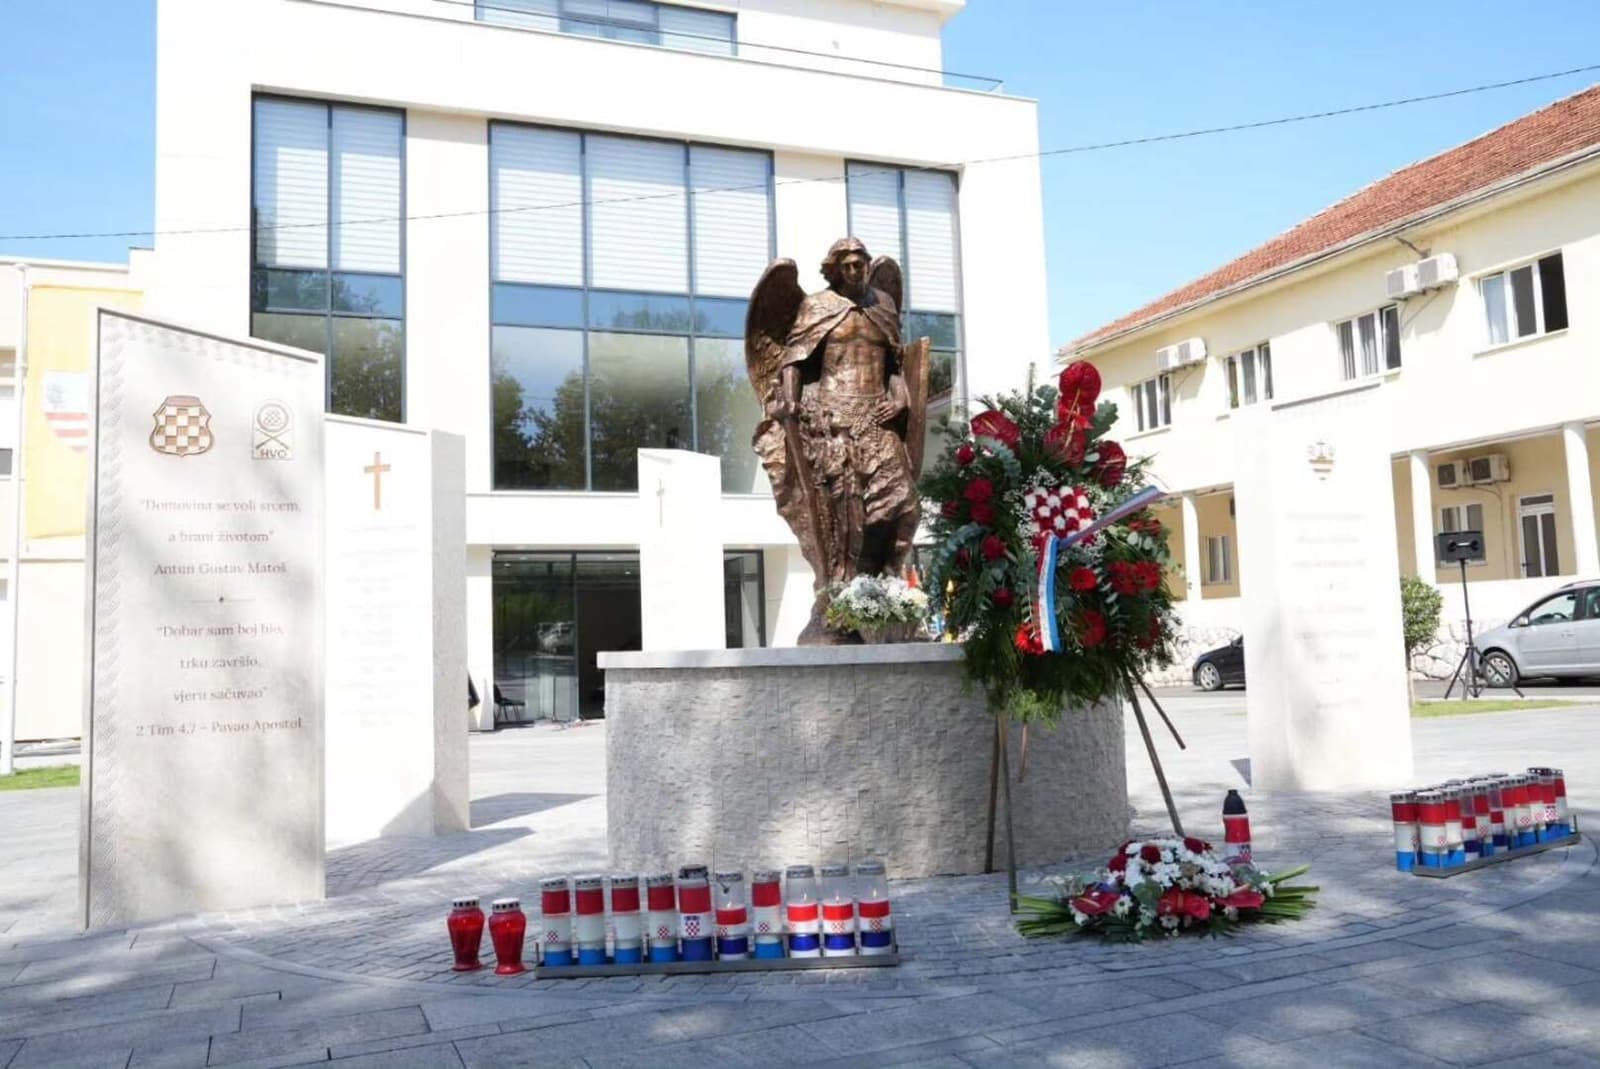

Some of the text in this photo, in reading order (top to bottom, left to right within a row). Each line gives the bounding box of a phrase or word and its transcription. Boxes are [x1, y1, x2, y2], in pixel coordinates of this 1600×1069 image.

[260, 450, 287, 459] HVO
[215, 502, 230, 512] se
[168, 532, 176, 542] a
[154, 562, 287, 575] Antun Gustav Matoš
[207, 626, 234, 636] sam
[237, 624, 257, 637] boj
[179, 657, 209, 669] trku
[173, 689, 207, 705] vjeru
[136, 725, 144, 736] 2
[149, 723, 174, 736] Tim
[211, 720, 250, 733] Pavao
[253, 717, 303, 732] Apostol
